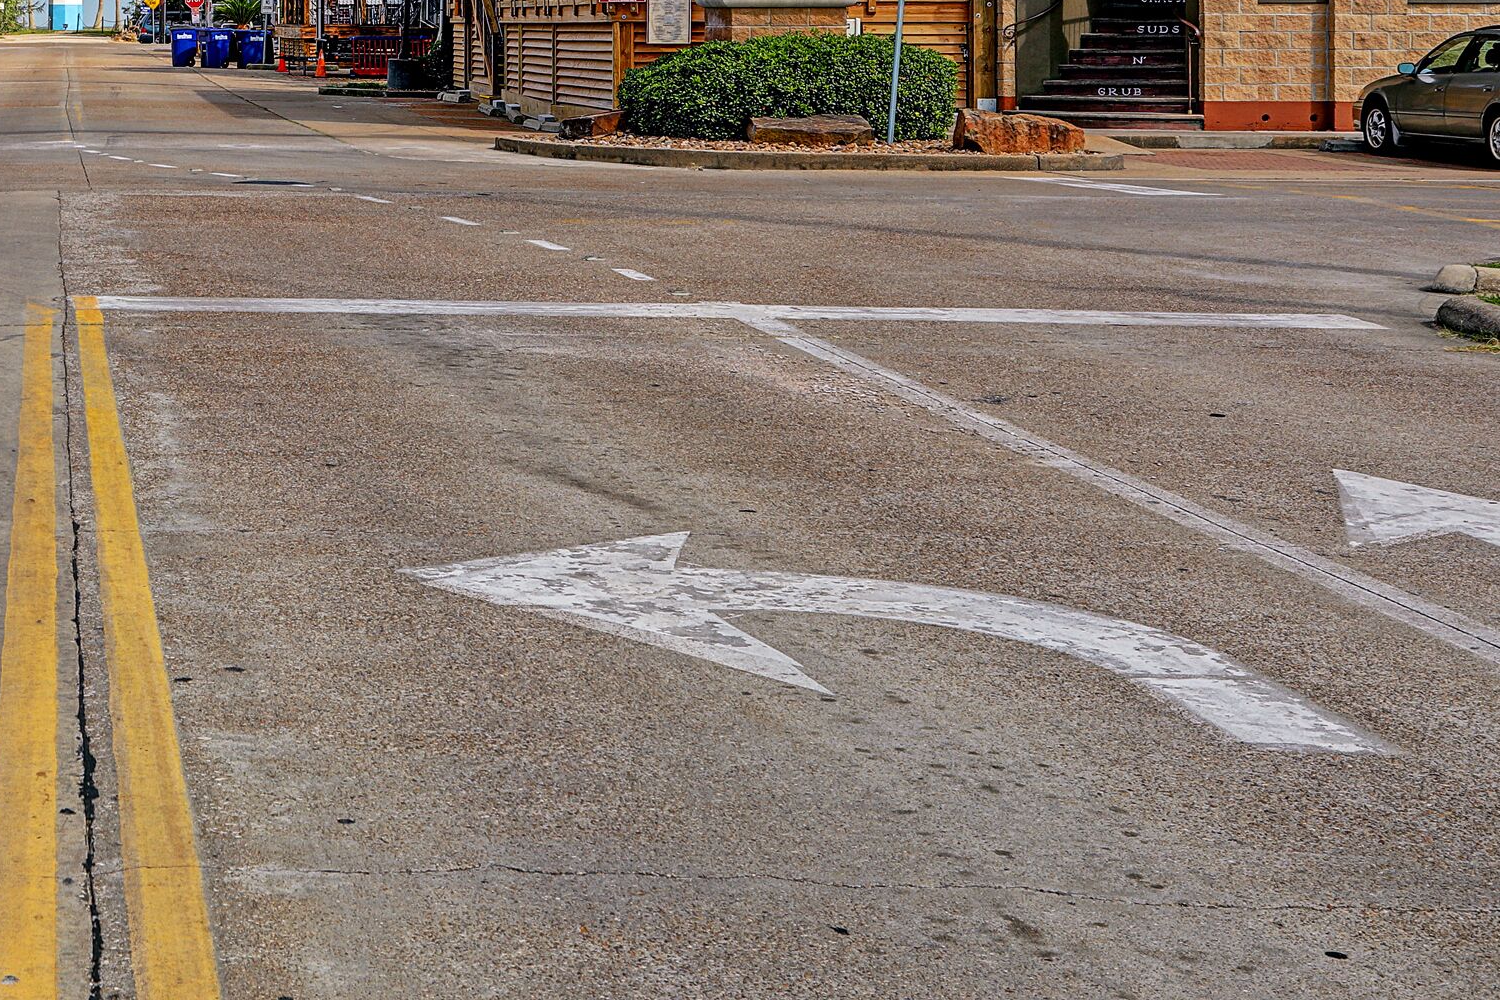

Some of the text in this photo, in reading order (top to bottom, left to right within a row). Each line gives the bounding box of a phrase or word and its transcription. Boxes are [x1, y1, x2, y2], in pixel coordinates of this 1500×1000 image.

[1136, 25, 1180, 34] SUDS
[1132, 56, 1147, 65] N'
[1097, 87, 1142, 96] GRUB
